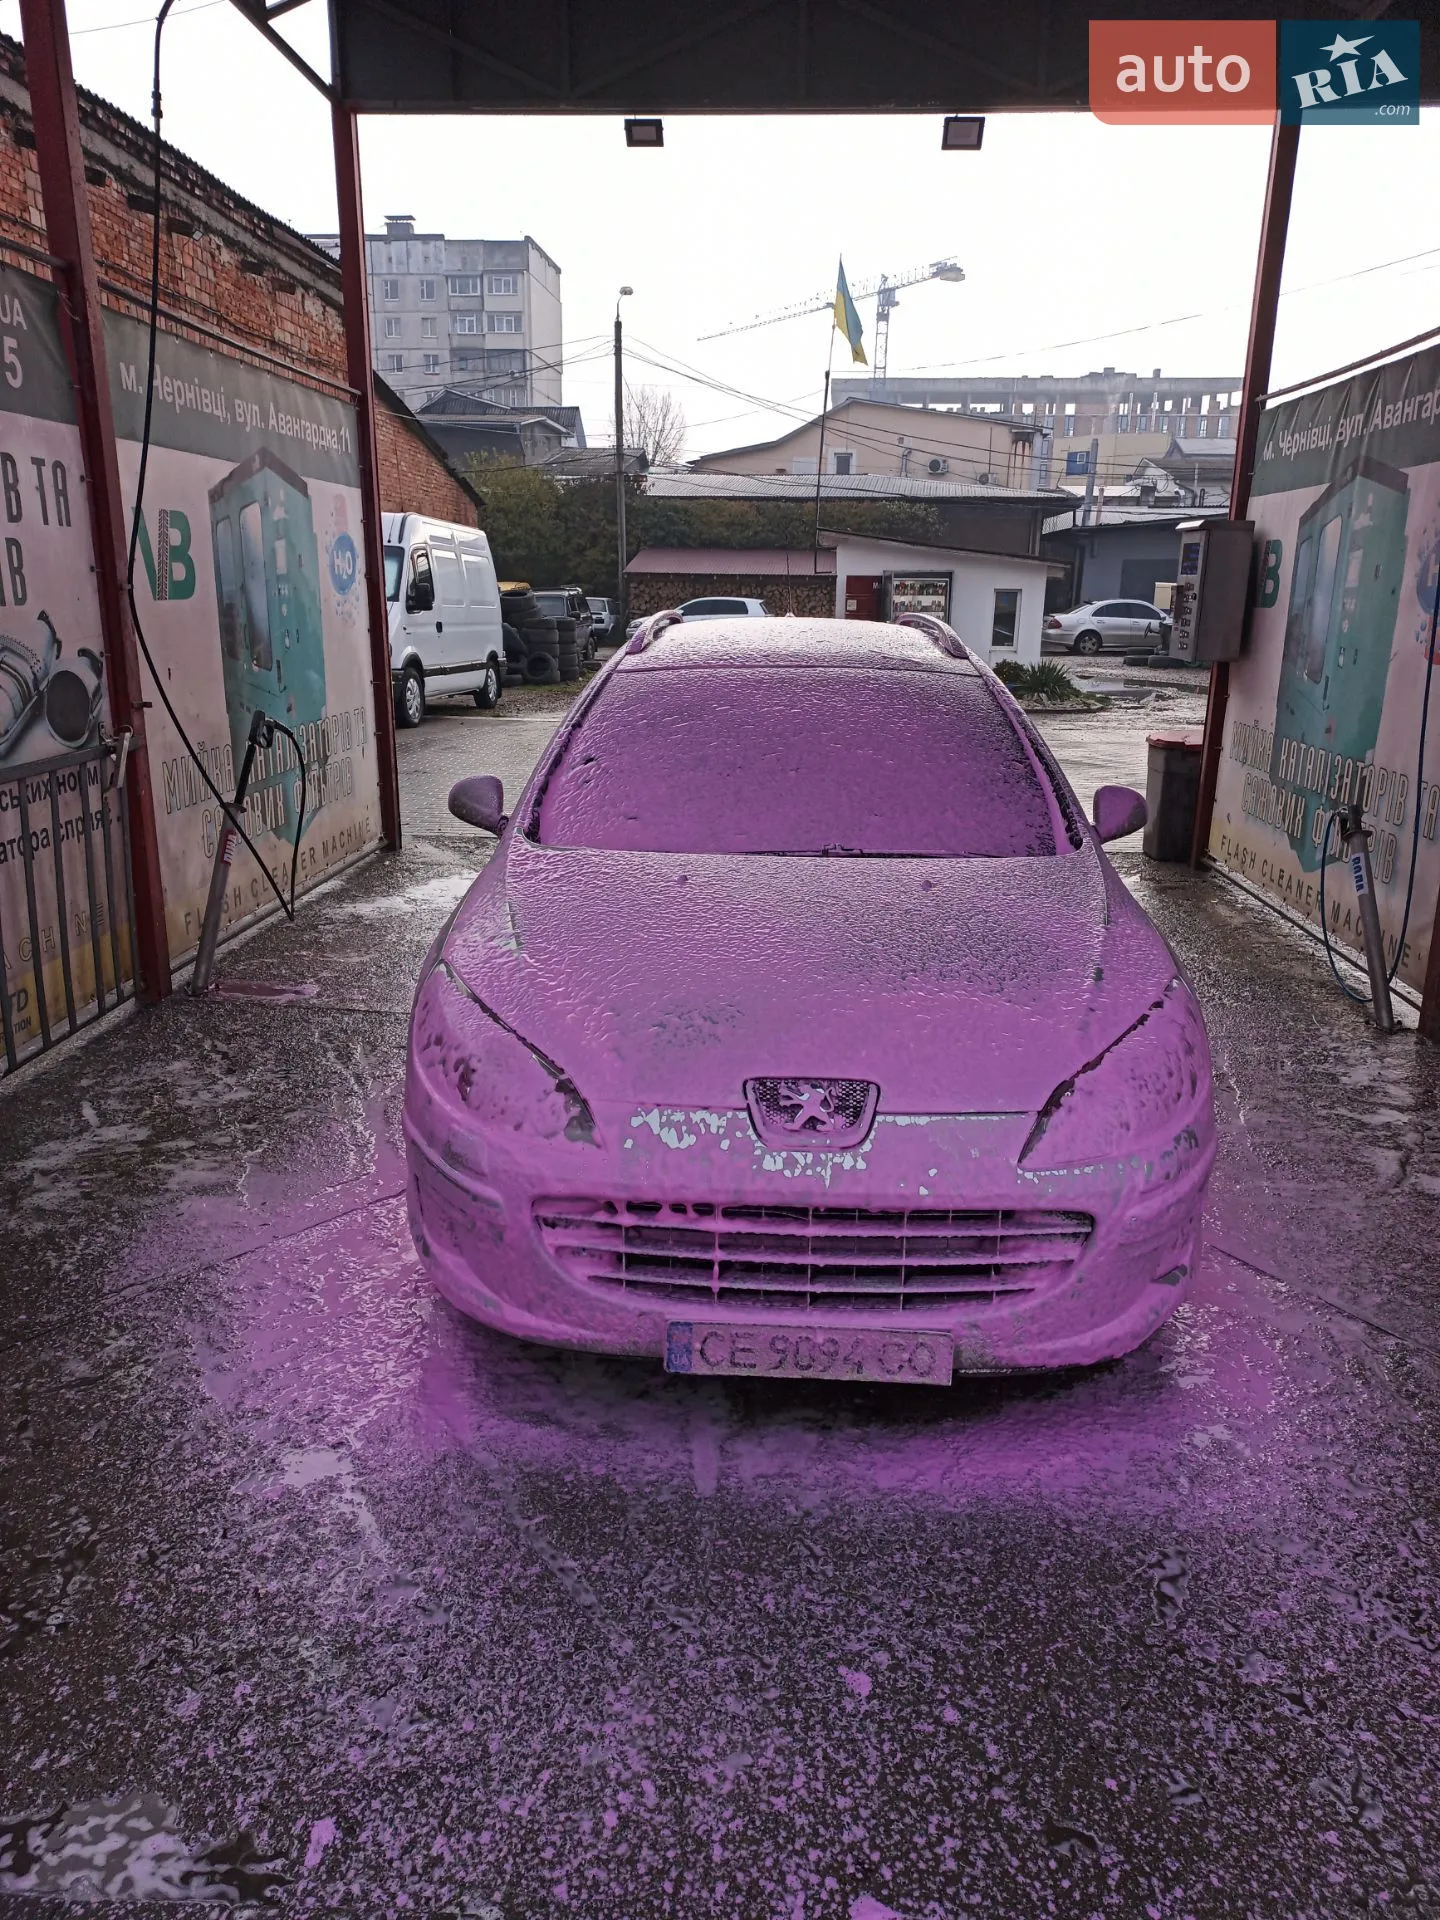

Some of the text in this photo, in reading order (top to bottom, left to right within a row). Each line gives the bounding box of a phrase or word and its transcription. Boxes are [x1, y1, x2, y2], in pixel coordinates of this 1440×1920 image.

[3, 336, 23, 389] 5
[234, 398, 265, 432] вул.
[1279, 415, 1333, 461] Чернівці,
[1336, 413, 1368, 447] вул.
[31, 456, 71, 527] ТА
[56, 766, 100, 795] ном
[162, 741, 235, 814] МИЙКА
[1242, 772, 1306, 839] САЖОВИХ
[1278, 737, 1409, 827] КАТАЛІЗАТОРІВ
[202, 778, 285, 858] САОВИХ
[184, 817, 371, 935] FLSH CLEAER MACHINE
[1220, 834, 1257, 871] FLASH
[1331, 901, 1412, 969] MACNE
